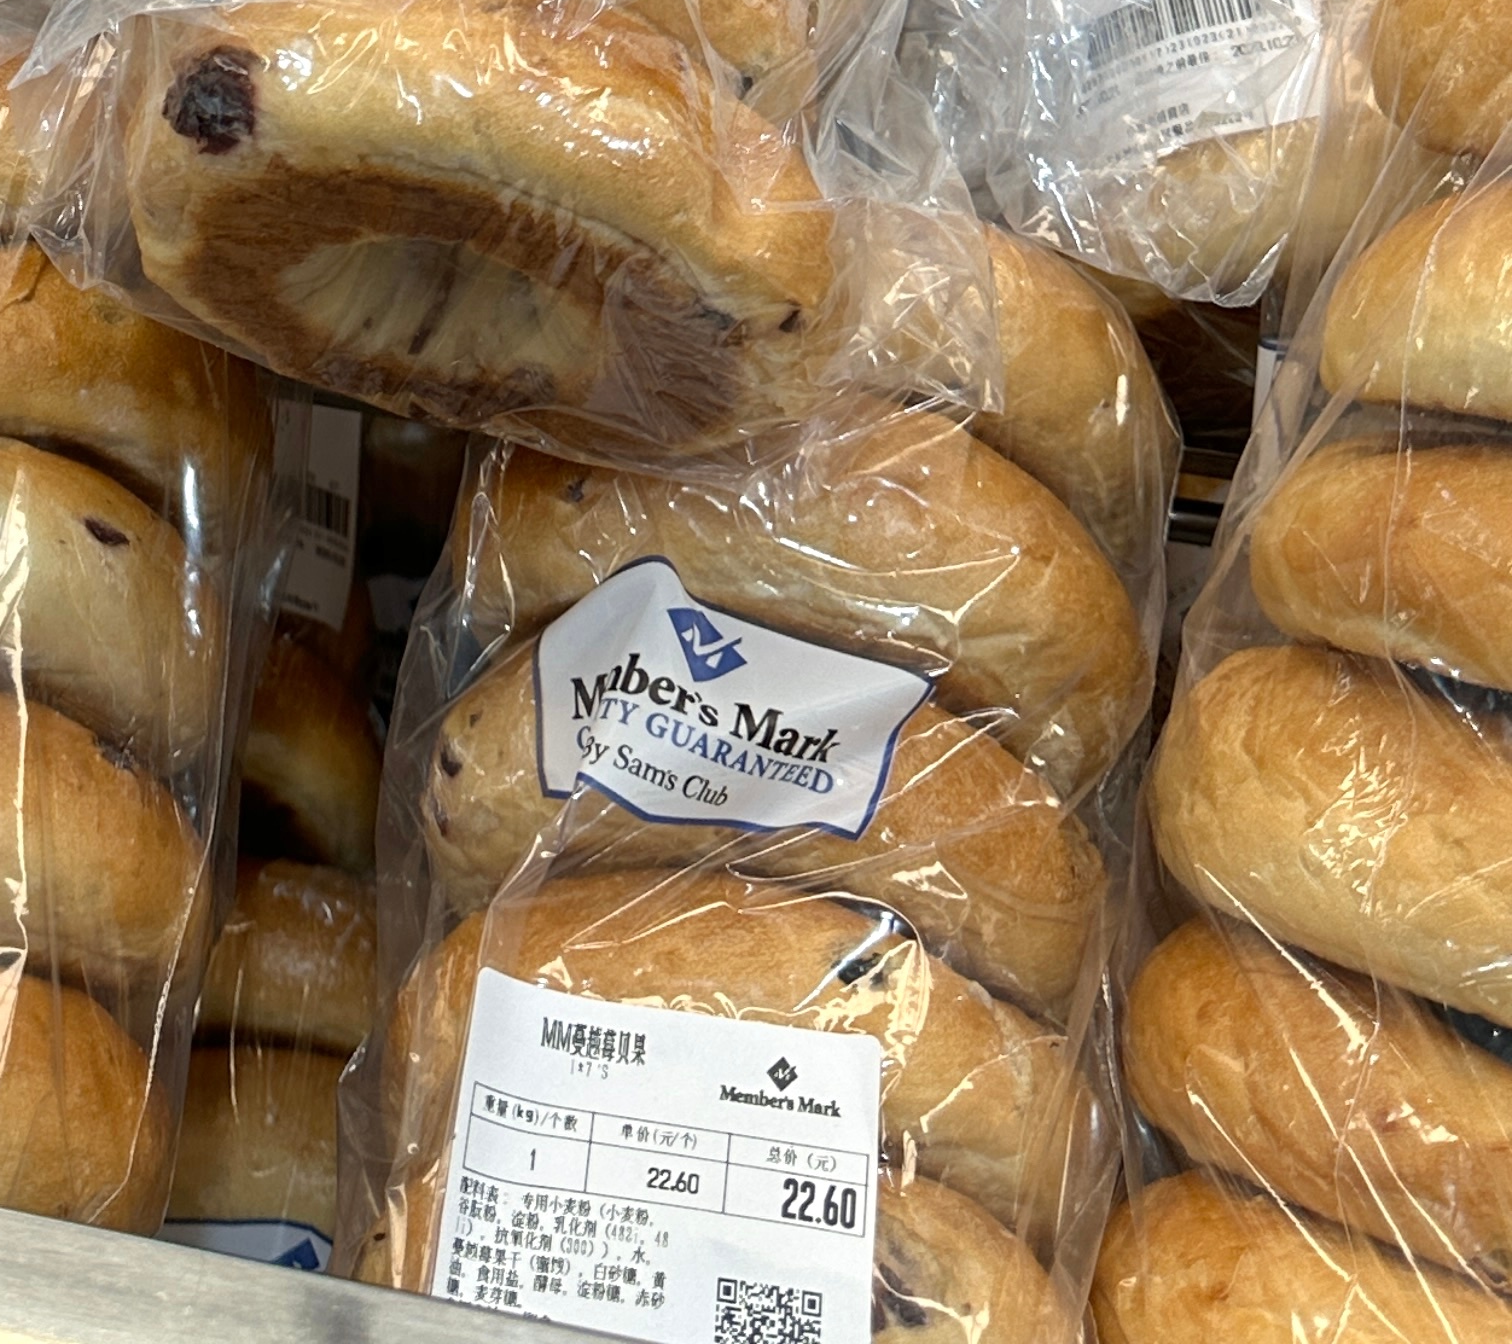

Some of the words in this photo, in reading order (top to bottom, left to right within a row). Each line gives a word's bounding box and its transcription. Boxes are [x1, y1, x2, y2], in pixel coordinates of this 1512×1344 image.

[645, 712, 834, 795] GUARANTEED
[729, 703, 840, 763] Mark
[613, 744, 679, 791] Sam's
[682, 775, 728, 807] Club
[540, 1016, 647, 1066] MM蔓越莓贝果
[719, 1084, 794, 1111] Member's
[797, 1096, 841, 1117] Mark
[529, 1148, 537, 1171] 1
[646, 1167, 700, 1194] 22.60
[781, 1177, 857, 1229] 22.60
